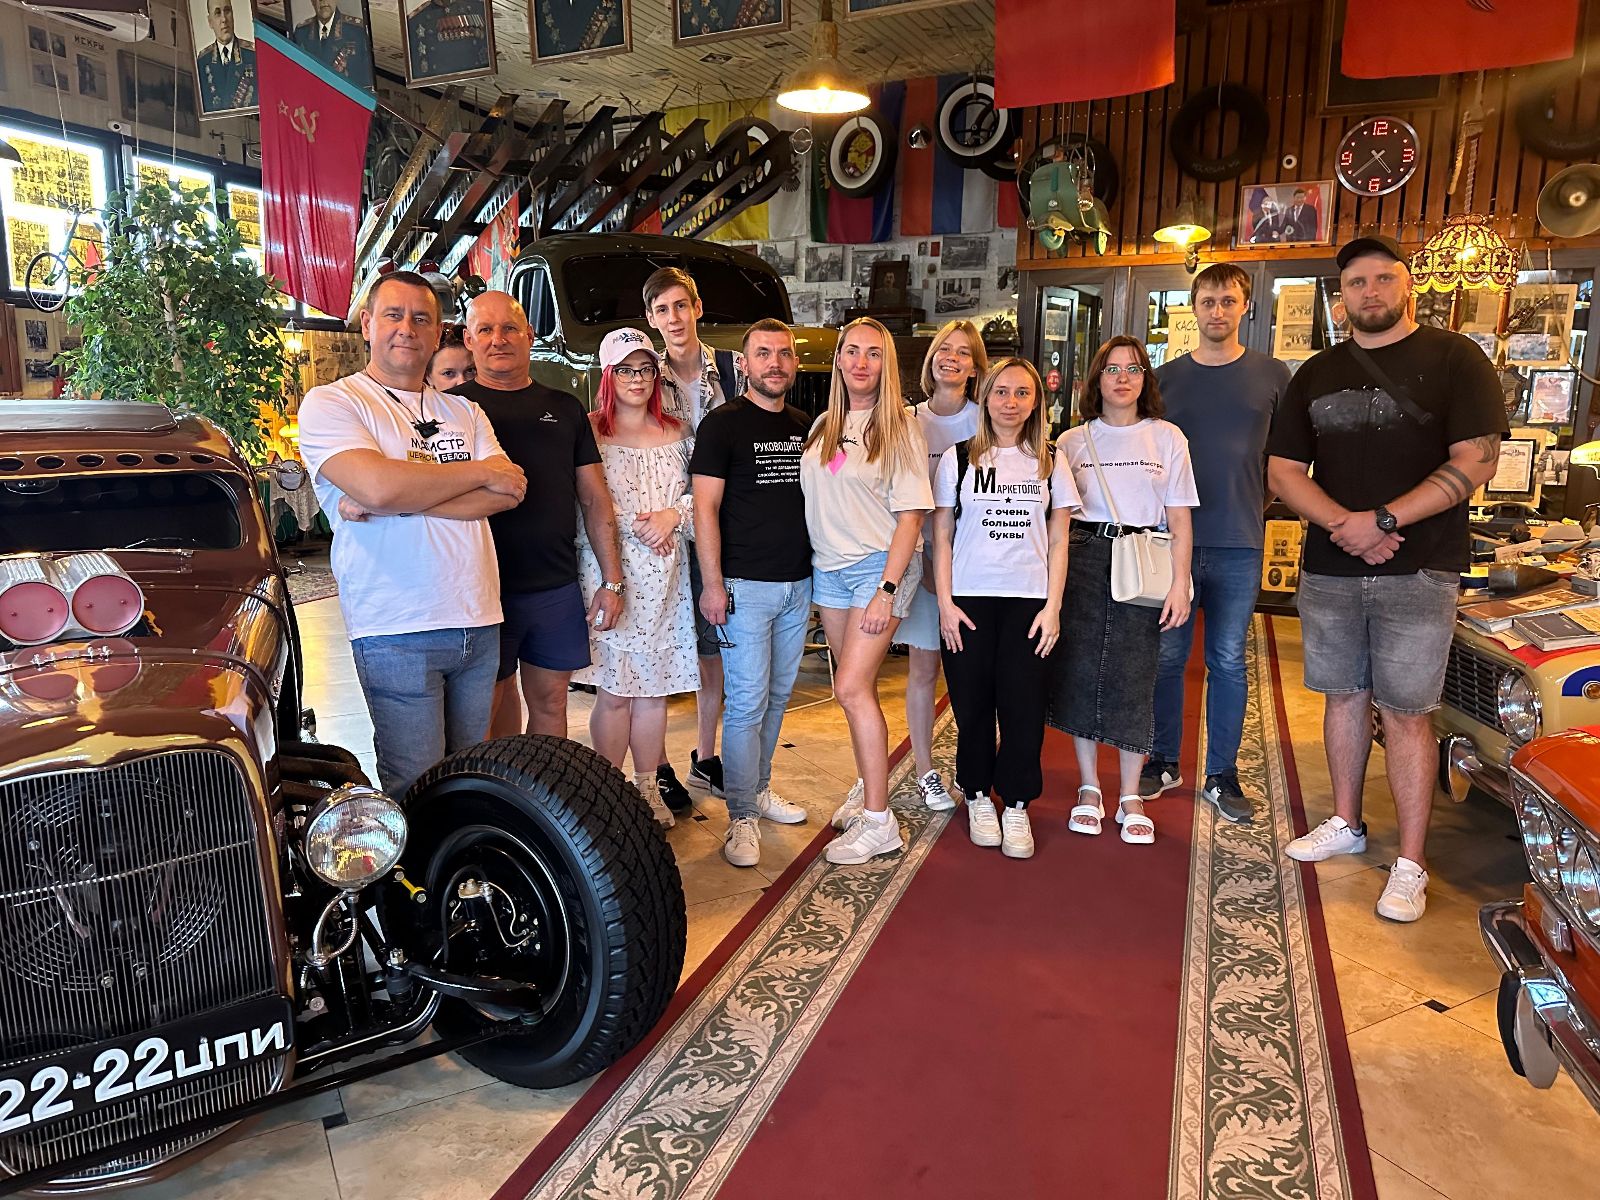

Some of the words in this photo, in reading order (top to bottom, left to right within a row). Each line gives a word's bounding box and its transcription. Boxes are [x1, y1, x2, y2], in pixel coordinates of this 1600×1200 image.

[1372, 121, 1389, 136] 12
[1340, 151, 1353, 166] 9
[1402, 148, 1415, 163] 3
[1367, 178, 1381, 192] 6
[1174, 319, 1198, 331] КАСС
[995, 508, 1030, 516] очень
[981, 518, 1032, 527] большой
[989, 530, 1025, 540] буквы
